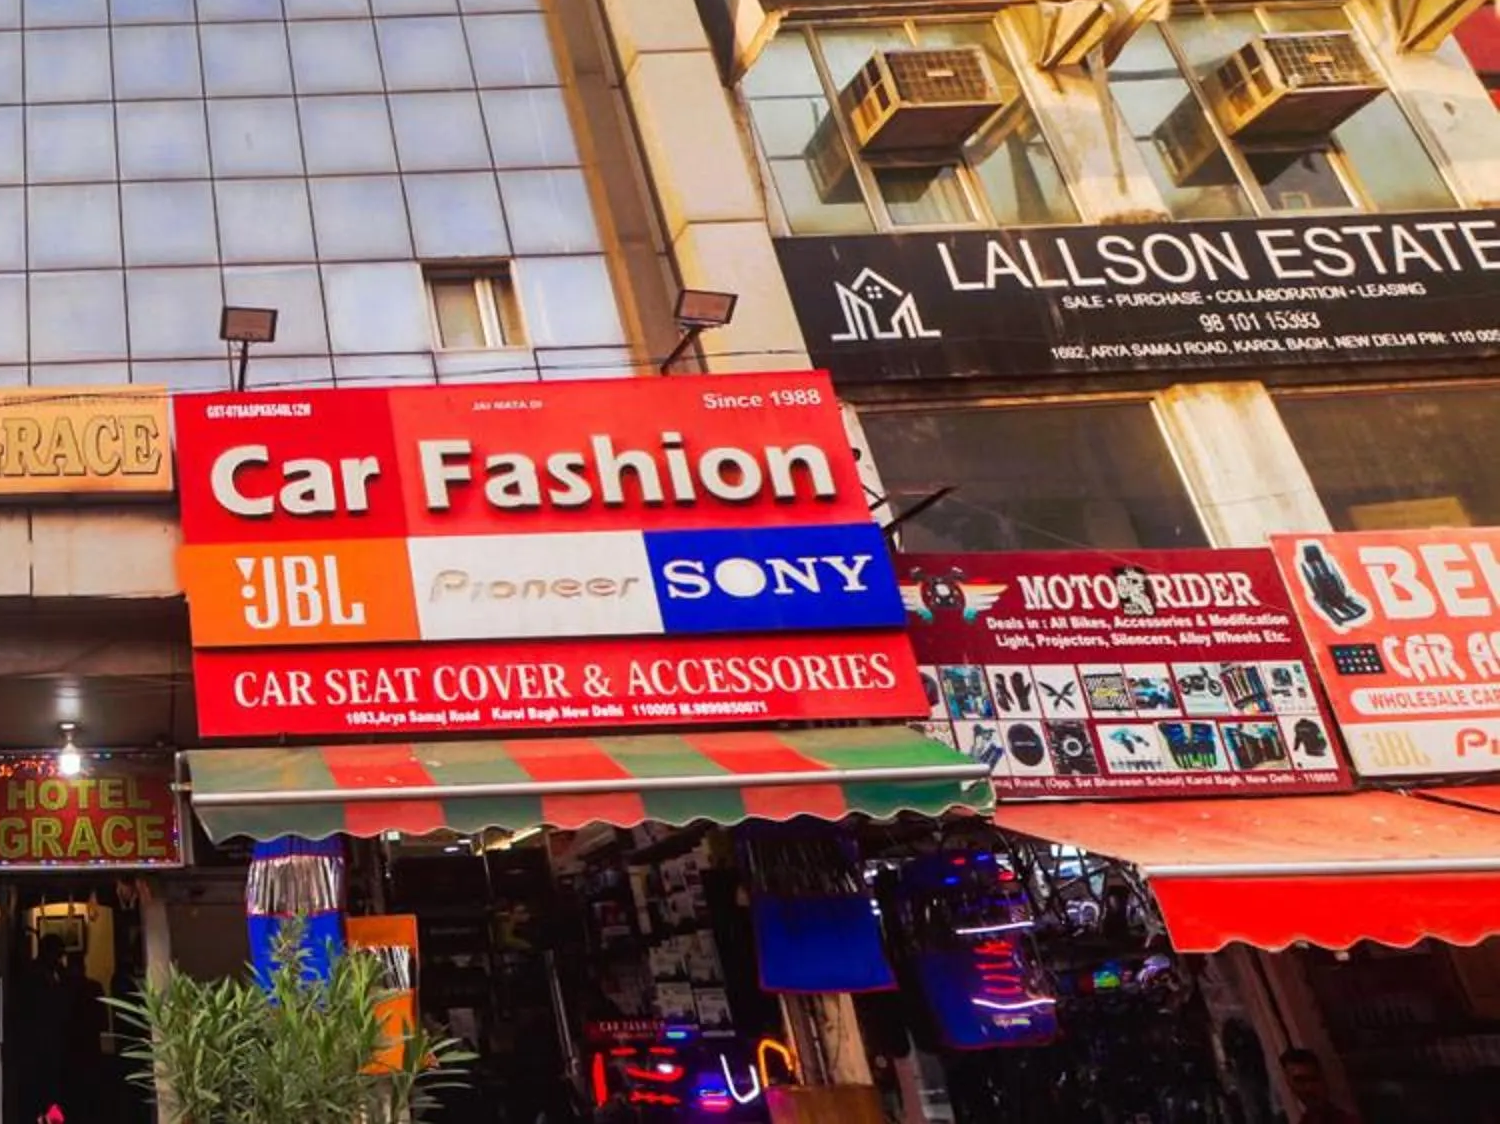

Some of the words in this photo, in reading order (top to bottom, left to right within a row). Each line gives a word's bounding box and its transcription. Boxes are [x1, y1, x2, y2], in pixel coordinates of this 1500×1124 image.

[938, 232, 1249, 291] LALLSON
[1256, 220, 1500, 279] ESTATE
[1062, 295, 1104, 309] SALE
[1116, 291, 1204, 307] PURCHASE
[1215, 287, 1348, 304] COLLABORATION
[1358, 282, 1426, 297] LEASING
[1199, 313, 1225, 332] 98
[1228, 312, 1260, 331] 101
[1091, 344, 1130, 358] ARYA
[1131, 342, 1181, 357] SAMAJ
[1183, 340, 1233, 356] ROAD,
[1234, 338, 1285, 354] KAROL
[1336, 333, 1369, 348] NEW
[1372, 331, 1416, 347] DELHI
[1451, 329, 1476, 344] 110
[703, 392, 763, 409] Since
[769, 388, 821, 406] 1988
[210, 443, 381, 517] Car
[417, 431, 838, 512] Fashion
[235, 555, 366, 630] JBL
[428, 569, 641, 605] Pioneer
[661, 555, 875, 601] SONY
[1017, 573, 1118, 611] MOTO
[1148, 571, 1261, 608] RIDER
[986, 615, 1025, 631] Deals
[1026, 615, 1041, 630] in
[1050, 615, 1069, 630] All
[1071, 615, 1112, 632] Bikes,
[1113, 614, 1194, 629] Accessories
[1195, 613, 1206, 627] &
[1208, 612, 1290, 627] Modification
[995, 633, 1034, 650] Light,
[1036, 632, 1110, 650] Projectors,
[1111, 631, 1177, 647] Silencers,
[1179, 630, 1212, 647] Alloy
[1213, 629, 1261, 645] Wheels
[1382, 632, 1467, 683] CAR
[233, 670, 317, 708] CAR
[324, 666, 422, 706] SEAT
[432, 662, 574, 703] COVER
[583, 663, 614, 698] &
[626, 652, 898, 697] ACCESSORIES
[408, 709, 448, 726] Samaj
[449, 709, 480, 722] Road
[490, 707, 525, 721] Karol
[527, 706, 560, 723] Bagh
[561, 705, 589, 720] New
[591, 703, 625, 718] Delhi
[1368, 689, 1466, 711] WHOLESALE
[6, 778, 153, 811] HOTEL
